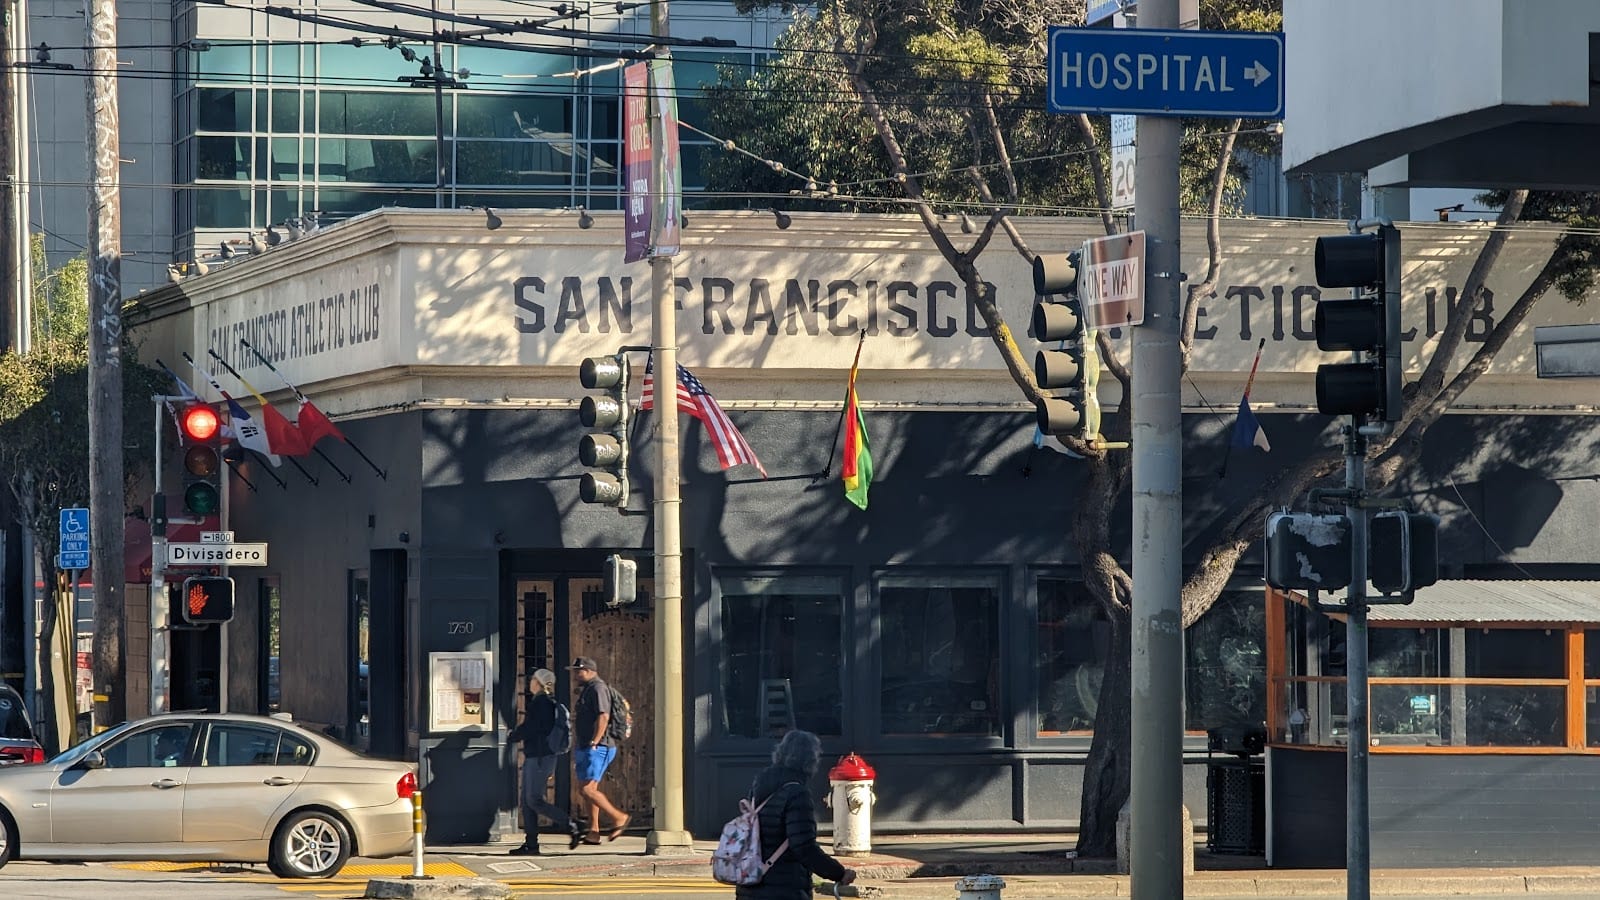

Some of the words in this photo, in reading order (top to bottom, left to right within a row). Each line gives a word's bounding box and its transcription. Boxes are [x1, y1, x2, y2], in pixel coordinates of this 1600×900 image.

[1062, 52, 1234, 92] HOSPITAL
[1114, 116, 1136, 134] SPEED
[1117, 137, 1135, 155] LIMI
[1116, 159, 1136, 196] 20
[1087, 268, 1108, 300] ONE
[1111, 262, 1136, 296] WAY
[513, 276, 633, 333] SAN
[211, 325, 230, 377] SAN
[233, 309, 286, 371] FRANCISCO
[290, 293, 344, 360] ATHLETIC
[349, 283, 380, 346] CLUB
[63, 532, 88, 542] PARKING
[212, 533, 231, 542] 1800
[66, 542, 83, 551] ONLY
[174, 547, 260, 560] Divisadero
[447, 622, 474, 634] 1750
